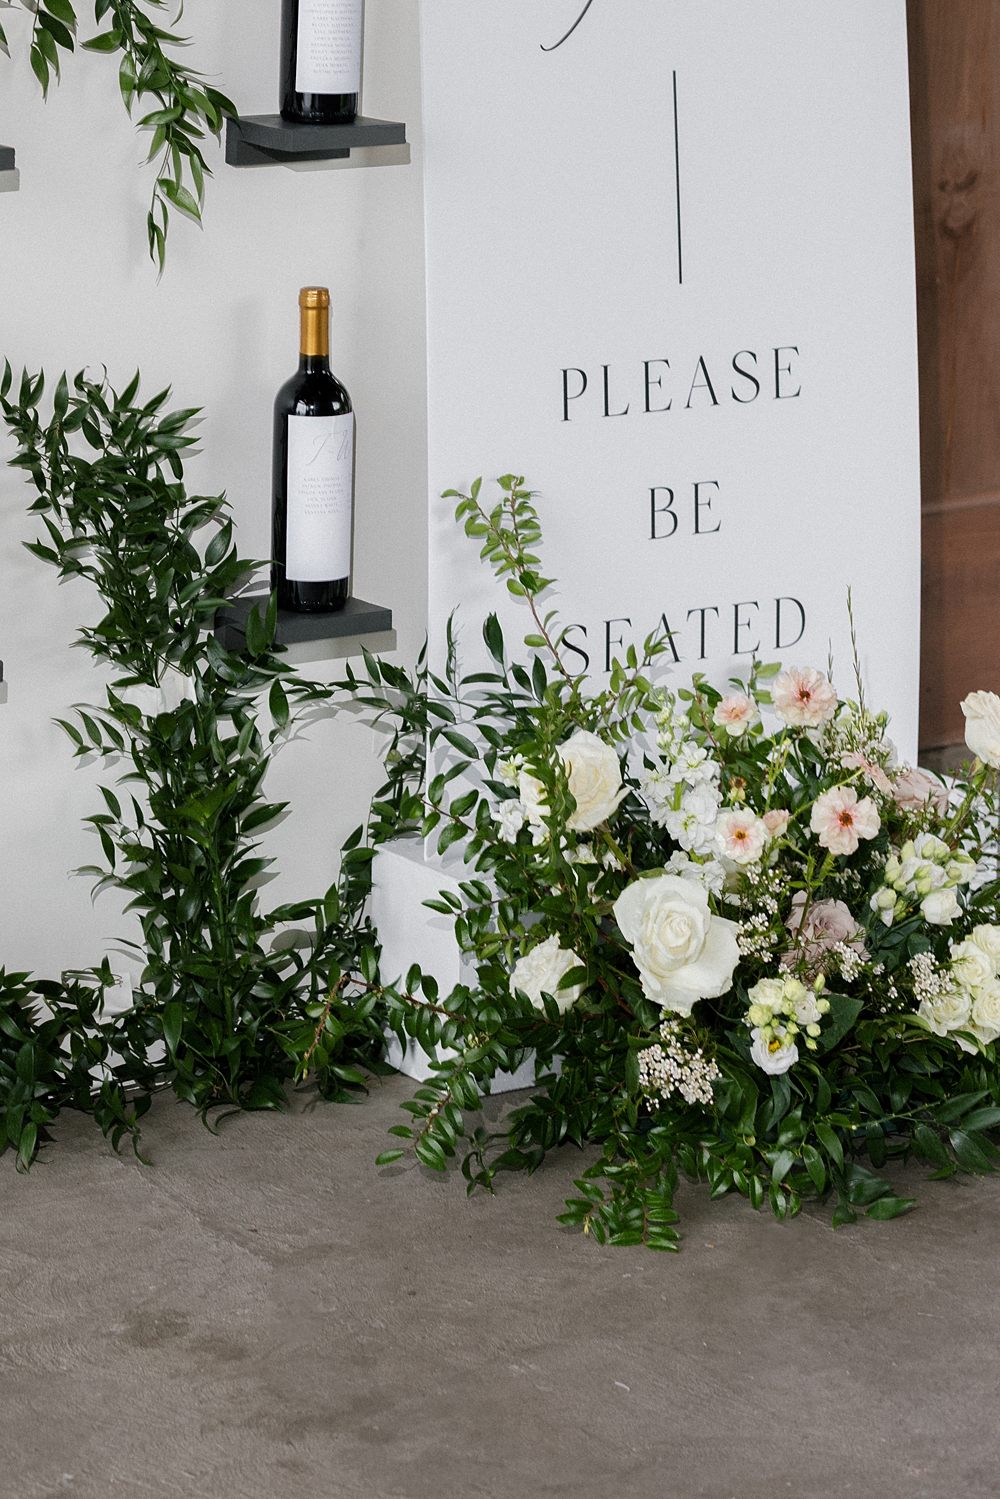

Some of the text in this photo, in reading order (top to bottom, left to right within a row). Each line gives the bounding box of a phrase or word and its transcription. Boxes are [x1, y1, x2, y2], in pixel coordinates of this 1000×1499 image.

[560, 346, 802, 422] PLEASE
[647, 480, 722, 540] BE
[560, 597, 806, 677] SEATED
